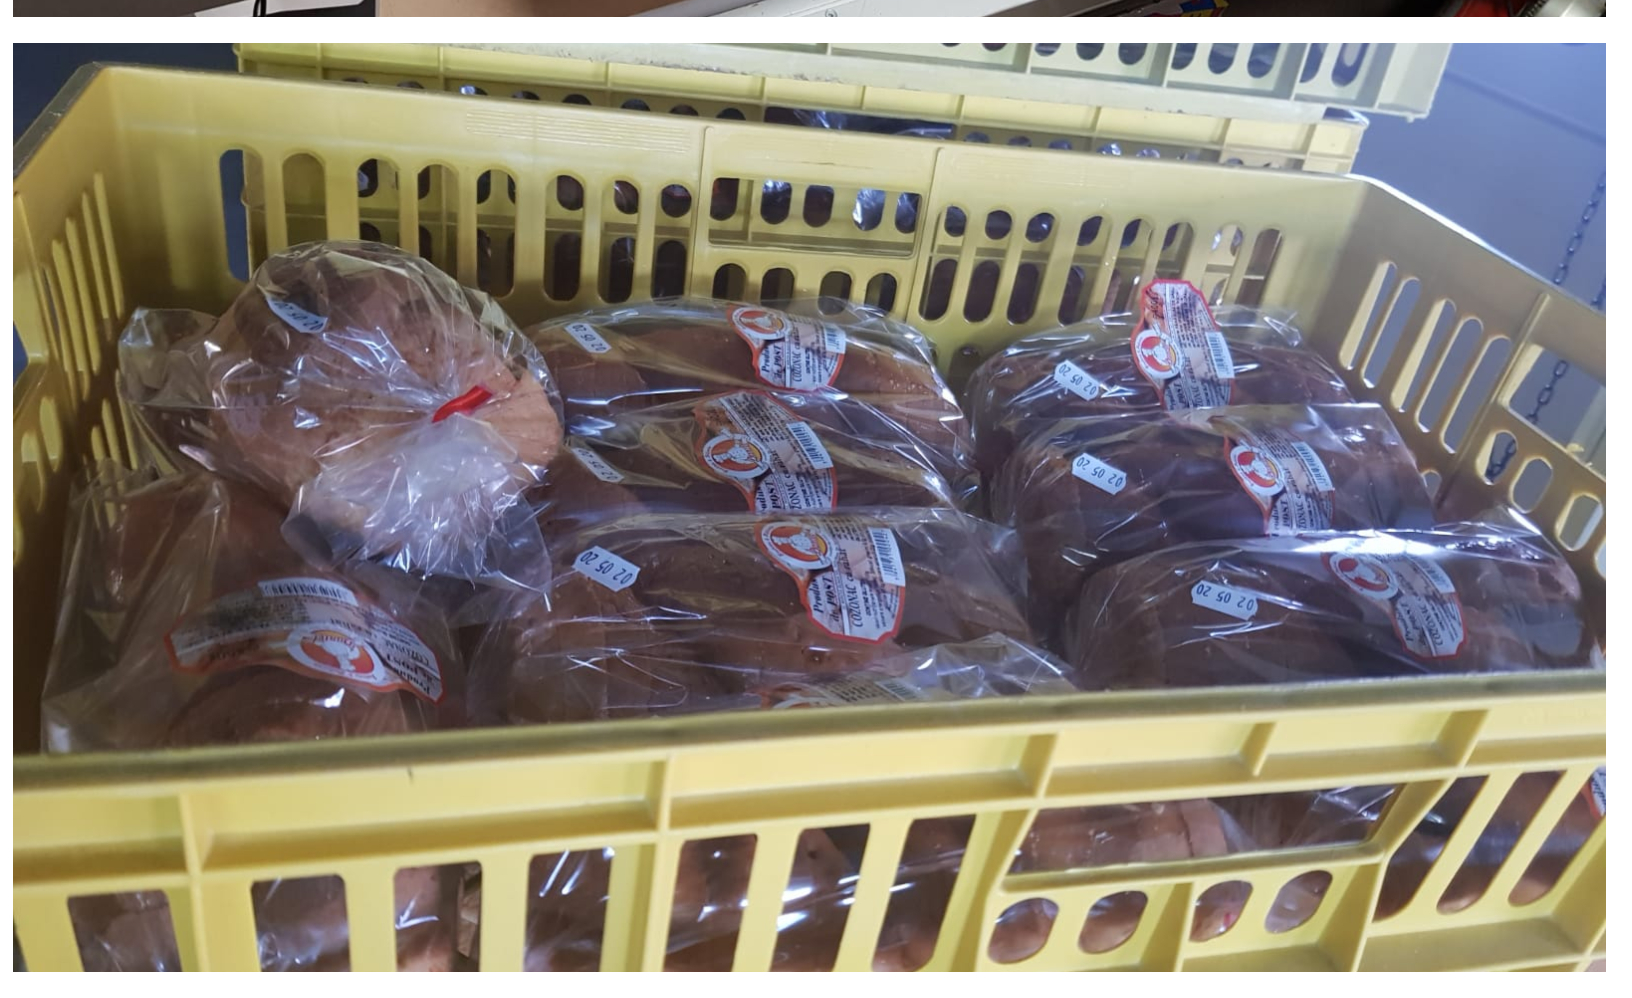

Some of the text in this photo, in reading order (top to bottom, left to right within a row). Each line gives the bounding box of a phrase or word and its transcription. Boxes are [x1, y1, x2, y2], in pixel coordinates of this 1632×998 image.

[1059, 364, 1096, 395] 02 05 20
[1076, 457, 1123, 487] 02 05 20
[580, 551, 632, 584] 02 05 20
[821, 576, 837, 606] POST
[844, 583, 863, 626] COZONAC
[1196, 584, 1254, 610] 02 05 20
